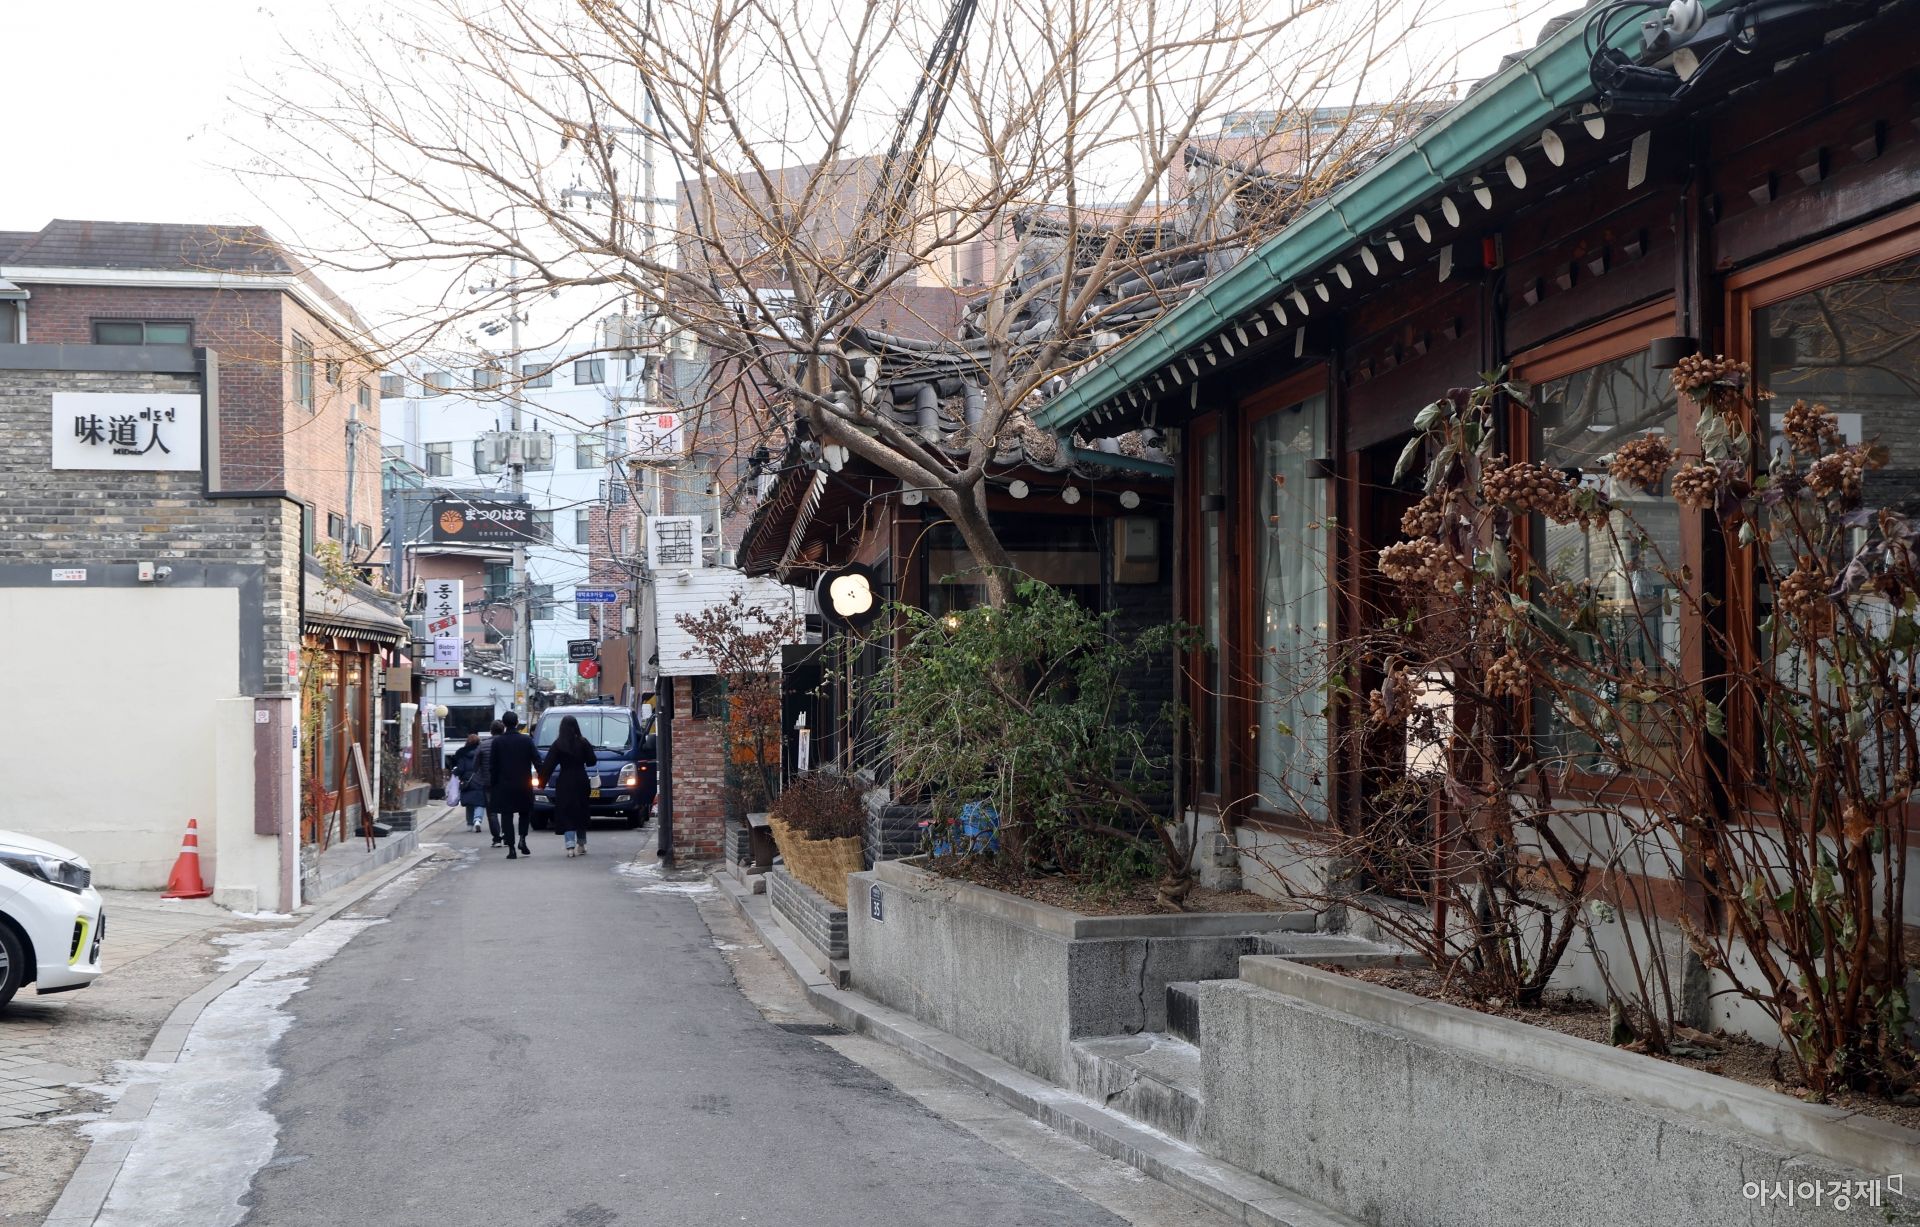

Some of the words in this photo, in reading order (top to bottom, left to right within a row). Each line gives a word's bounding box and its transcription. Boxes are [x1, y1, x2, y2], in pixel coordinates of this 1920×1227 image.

[139, 407, 176, 423] 미도인
[74, 413, 170, 454] 味道人
[635, 433, 677, 455] 식당
[464, 508, 527, 521] まつのはな
